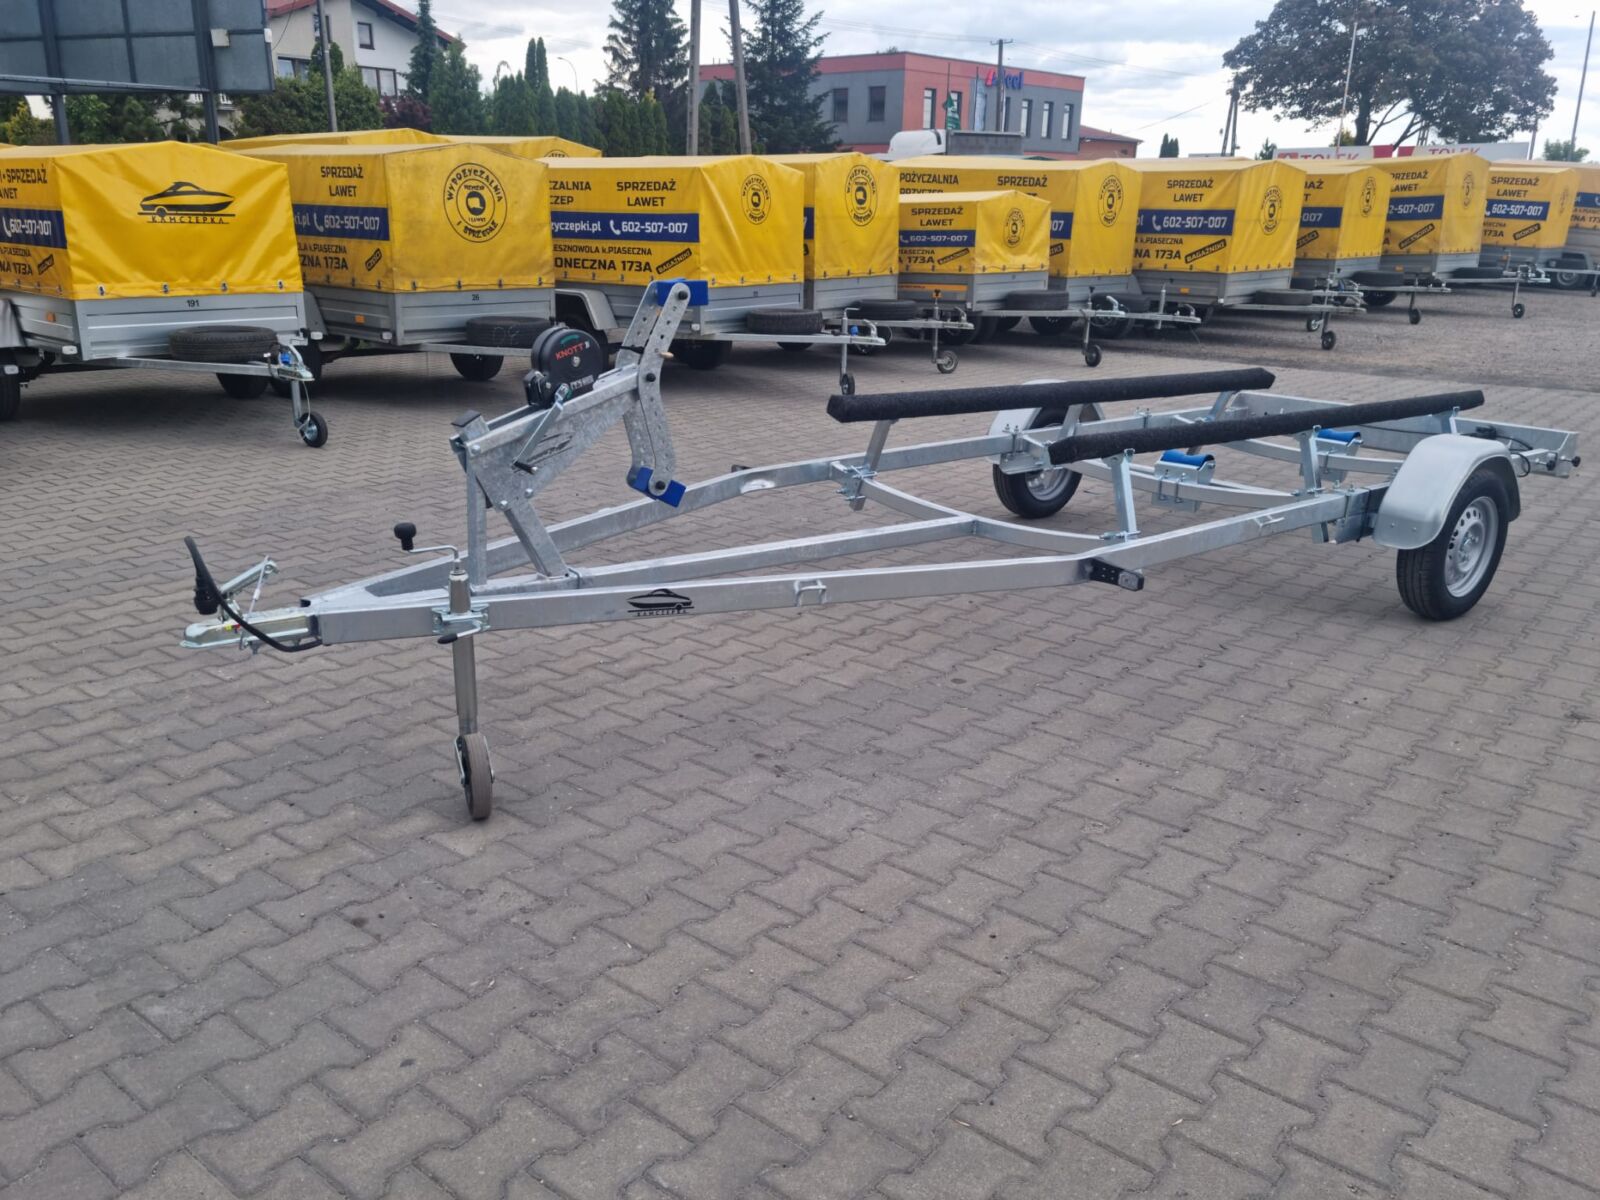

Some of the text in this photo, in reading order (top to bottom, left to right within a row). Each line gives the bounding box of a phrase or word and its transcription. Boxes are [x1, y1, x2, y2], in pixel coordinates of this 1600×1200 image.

[320, 164, 364, 179] SPRZEDAŻ
[616, 178, 676, 192] SPRZEDAŻ
[997, 175, 1048, 188] SPRZEDAŻ
[1167, 177, 1214, 189] SPRZEDAŻ
[1491, 176, 1540, 186] SPRZEDAŻ
[328, 185, 357, 197] LAWET
[1496, 189, 1528, 198] LAWET
[626, 196, 666, 207] LAWET
[1173, 193, 1204, 202] LAWET
[911, 206, 964, 216] SPRZEDAŻ
[1492, 204, 1543, 216] 602-507-007
[324, 214, 380, 230] 602-507-007
[621, 221, 688, 234] 602-507-007
[919, 218, 954, 227] LAWET
[1163, 216, 1228, 228] 602-507-007
[909, 234, 968, 242] 602-507-007
[907, 256, 935, 264] 173A
[1155, 250, 1181, 260] 173A
[323, 257, 349, 270] 173A
[621, 260, 653, 273] 173A
[186, 299, 200, 307] 191
[555, 342, 584, 361] KNOTT
